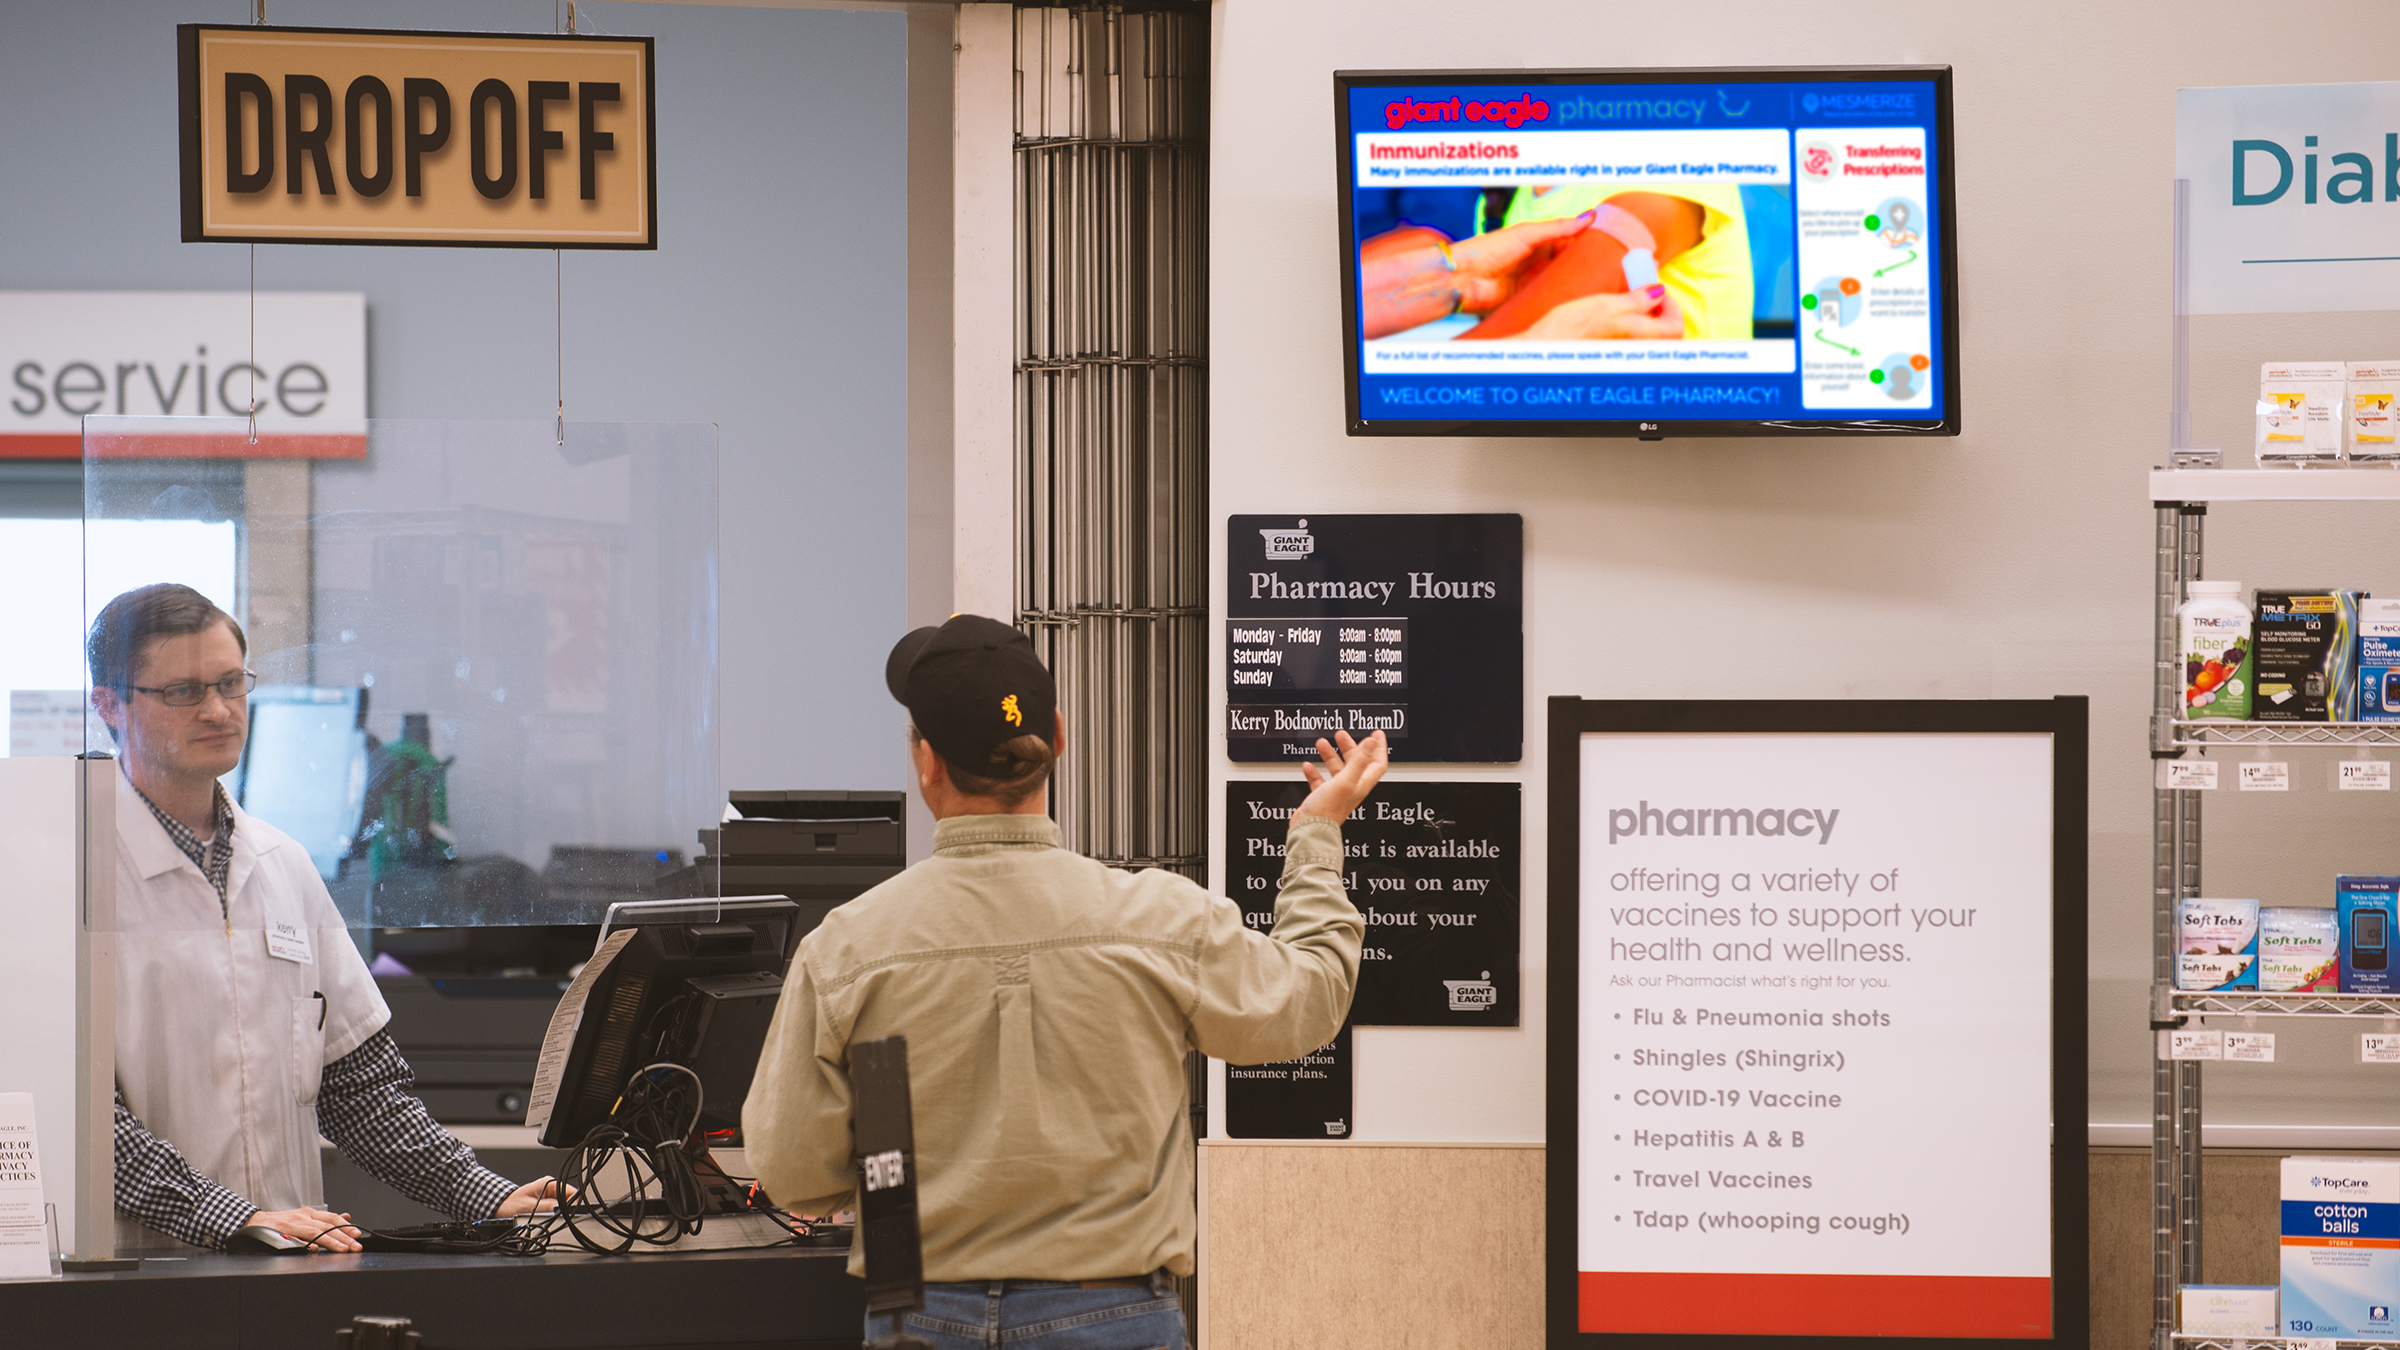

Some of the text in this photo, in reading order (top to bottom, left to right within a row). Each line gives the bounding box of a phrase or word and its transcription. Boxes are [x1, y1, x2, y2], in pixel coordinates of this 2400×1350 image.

[1821, 94, 1915, 109] MESMERIZE
[1385, 93, 1707, 130] giant eagle pharmacy
[225, 72, 621, 200] DROP OFF
[1370, 142, 1519, 159] Immunizations
[1846, 145, 1921, 161] Transferring
[1370, 163, 1779, 178] Many immunizations are available right in your Giant Eagle Pharmacy.
[1844, 163, 1925, 178] Prescriptions
[1376, 352, 1391, 360] For
[1401, 351, 1414, 360] full
[1416, 351, 1429, 360] list
[1431, 351, 1441, 360] of
[1442, 351, 1504, 360] recommended
[1547, 351, 1575, 361] please
[1577, 351, 1601, 361] speak
[1605, 351, 1624, 360] with
[1626, 353, 1645, 361] your
[1647, 351, 1671, 360] Giant
[1673, 351, 1697, 361] Eagle
[12, 345, 329, 417] service
[1379, 386, 1780, 405] WELCOME TO GIANT EAGLE PHARMACY!
[1274, 536, 1309, 544] GIANT
[1249, 572, 1497, 605] Pharmacy Hours
[2261, 605, 2285, 614] TRUE
[2261, 613, 2320, 622] METRIX
[2193, 617, 2241, 629] TRUEplus
[2306, 621, 2321, 630] GO
[1233, 627, 1402, 646] Monday Friday 9:00am 8:00pm
[2193, 636, 2227, 650] fiber
[2363, 641, 2388, 650] Pulse
[1233, 648, 1402, 666] Saturday 9:00am 6:00pm
[1233, 669, 1402, 687] Sunday 9:00am 5:00pm
[1230, 709, 1405, 735] Kerry Bodnovich PharmD
[1246, 801, 1297, 820] Your
[1375, 801, 1435, 825] Eagle
[1609, 800, 1840, 845] pharmacy
[1246, 838, 1501, 858] Phaist is available
[1246, 875, 1267, 890] to
[1367, 878, 1406, 895] you
[1415, 877, 1443, 891] on
[1452, 877, 1490, 896] any
[1610, 868, 1899, 898] offering a variety of
[1427, 912, 1477, 930] your
[1610, 903, 1978, 932] vaccines to support your
[2185, 914, 2243, 929] Soft Tabs
[2264, 936, 2322, 946] Soft Tabs
[1610, 937, 1911, 963] health and wellness.
[2182, 964, 2222, 973] Soft Tabs
[2262, 964, 2280, 974] Soft
[1457, 987, 1493, 995] GIANT
[1609, 974, 1891, 991] Ask our Pharmacist what's right for you.
[1457, 995, 1492, 1003] EAGLE
[1633, 1008, 1891, 1027] Flu & Pneumonia shots
[1633, 1048, 1845, 1072] Shingles (Shingrix)
[1230, 1067, 1328, 1081] insurance plans.
[1633, 1089, 1842, 1108] COVID-19 Vaccine
[18, 1141, 32, 1150] OF
[1633, 1130, 1805, 1151] Hepatitis A & B
[865, 1149, 905, 1193] ENTER
[1633, 1170, 1813, 1189] Travel Vaccines
[2322, 1177, 2369, 1189] TopCare
[2314, 1204, 2368, 1219] cotton
[1633, 1210, 1910, 1235] Tdap (whooping cough)
[2322, 1218, 2360, 1234] balls
[2289, 1320, 2313, 1332] 130
